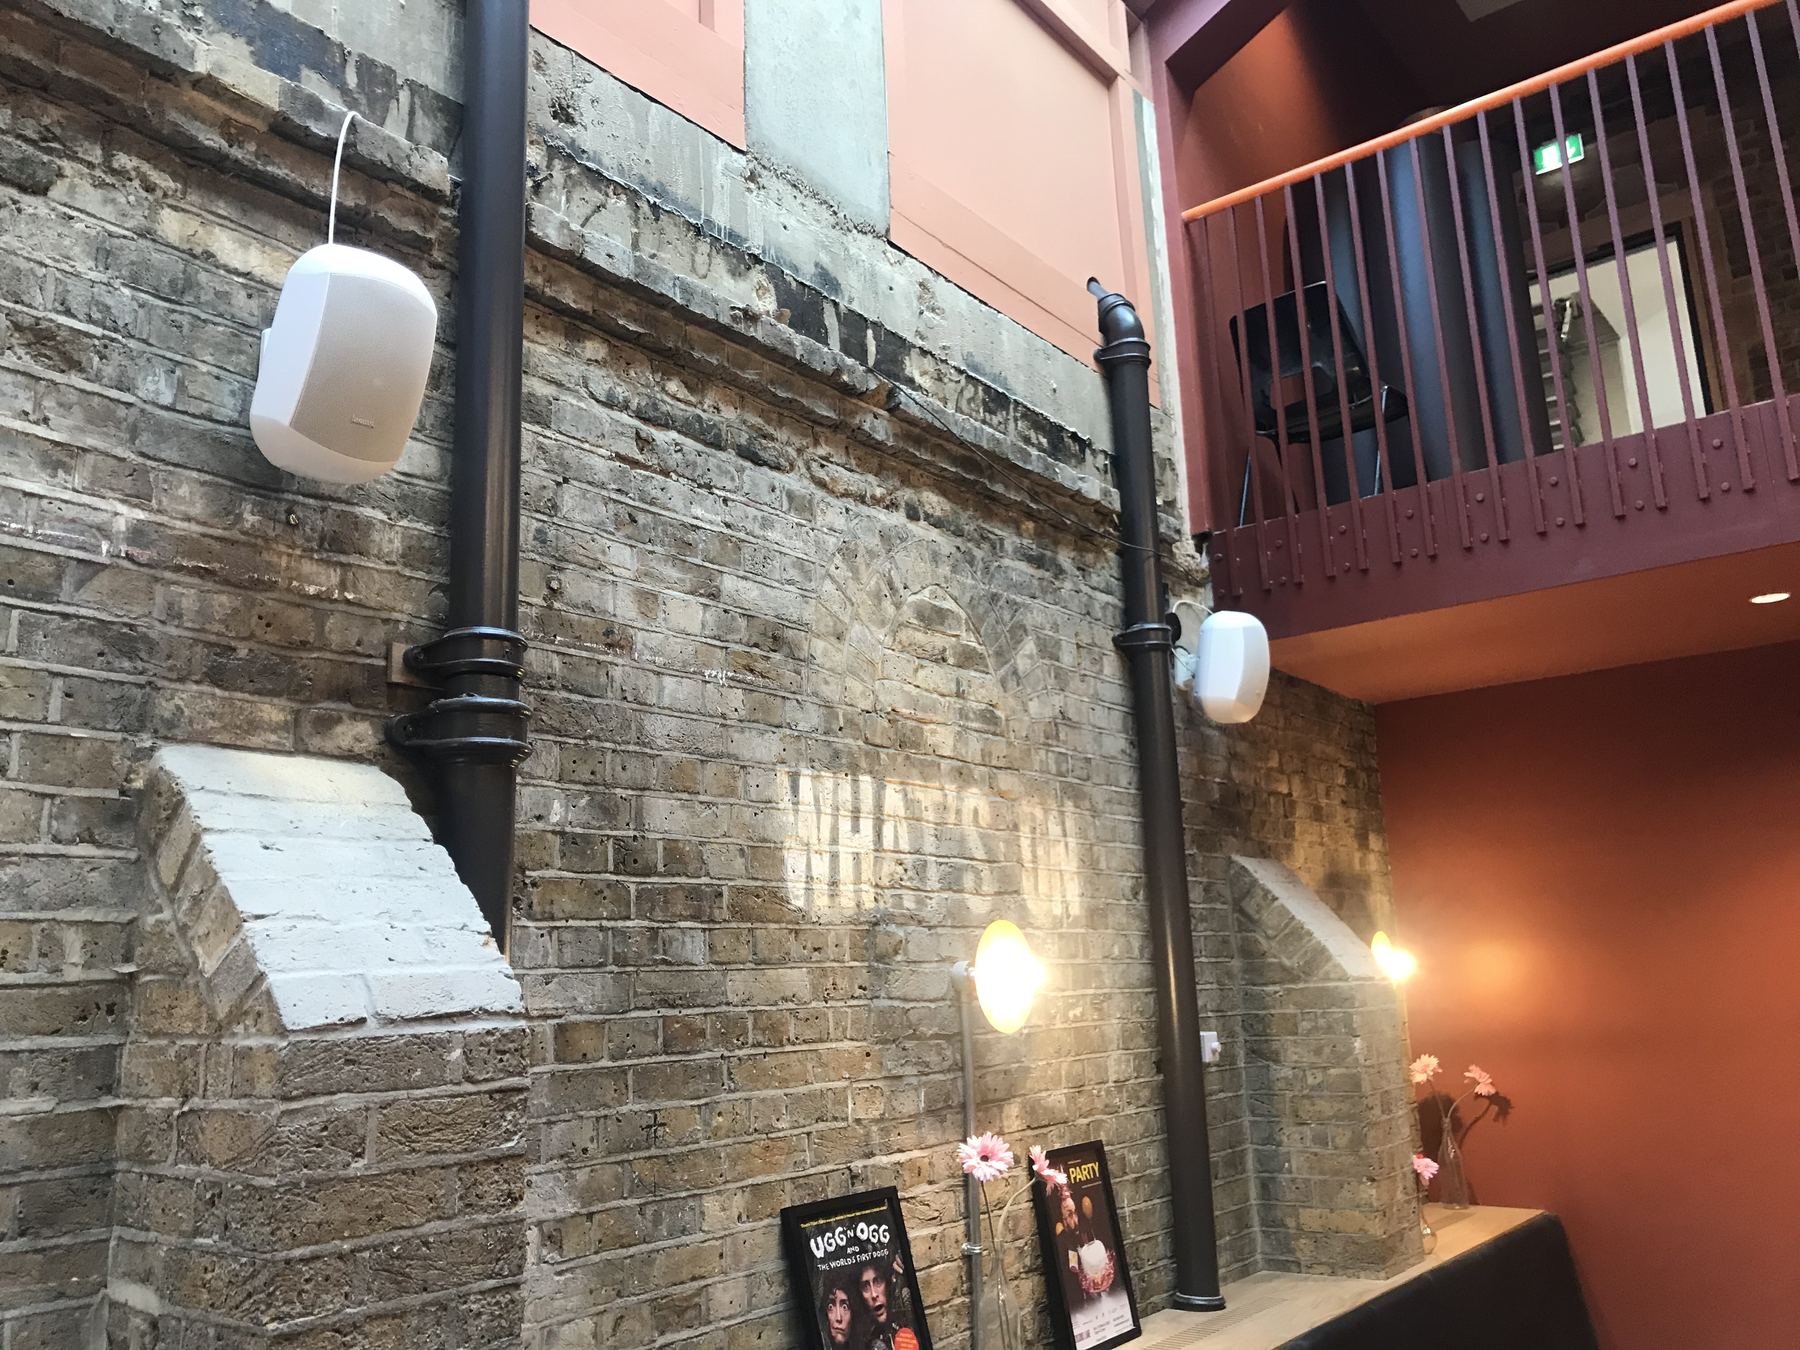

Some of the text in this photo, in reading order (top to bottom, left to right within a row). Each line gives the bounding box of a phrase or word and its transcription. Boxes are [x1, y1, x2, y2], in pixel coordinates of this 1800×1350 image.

[1069, 1162, 1099, 1184] PARTY
[810, 1226, 847, 1258] UGG
[856, 1222, 890, 1244] OGG
[847, 1246, 860, 1254] AND
[817, 1263, 829, 1271] THE
[856, 1252, 872, 1263] FIRST
[872, 1249, 889, 1258] DOGG
